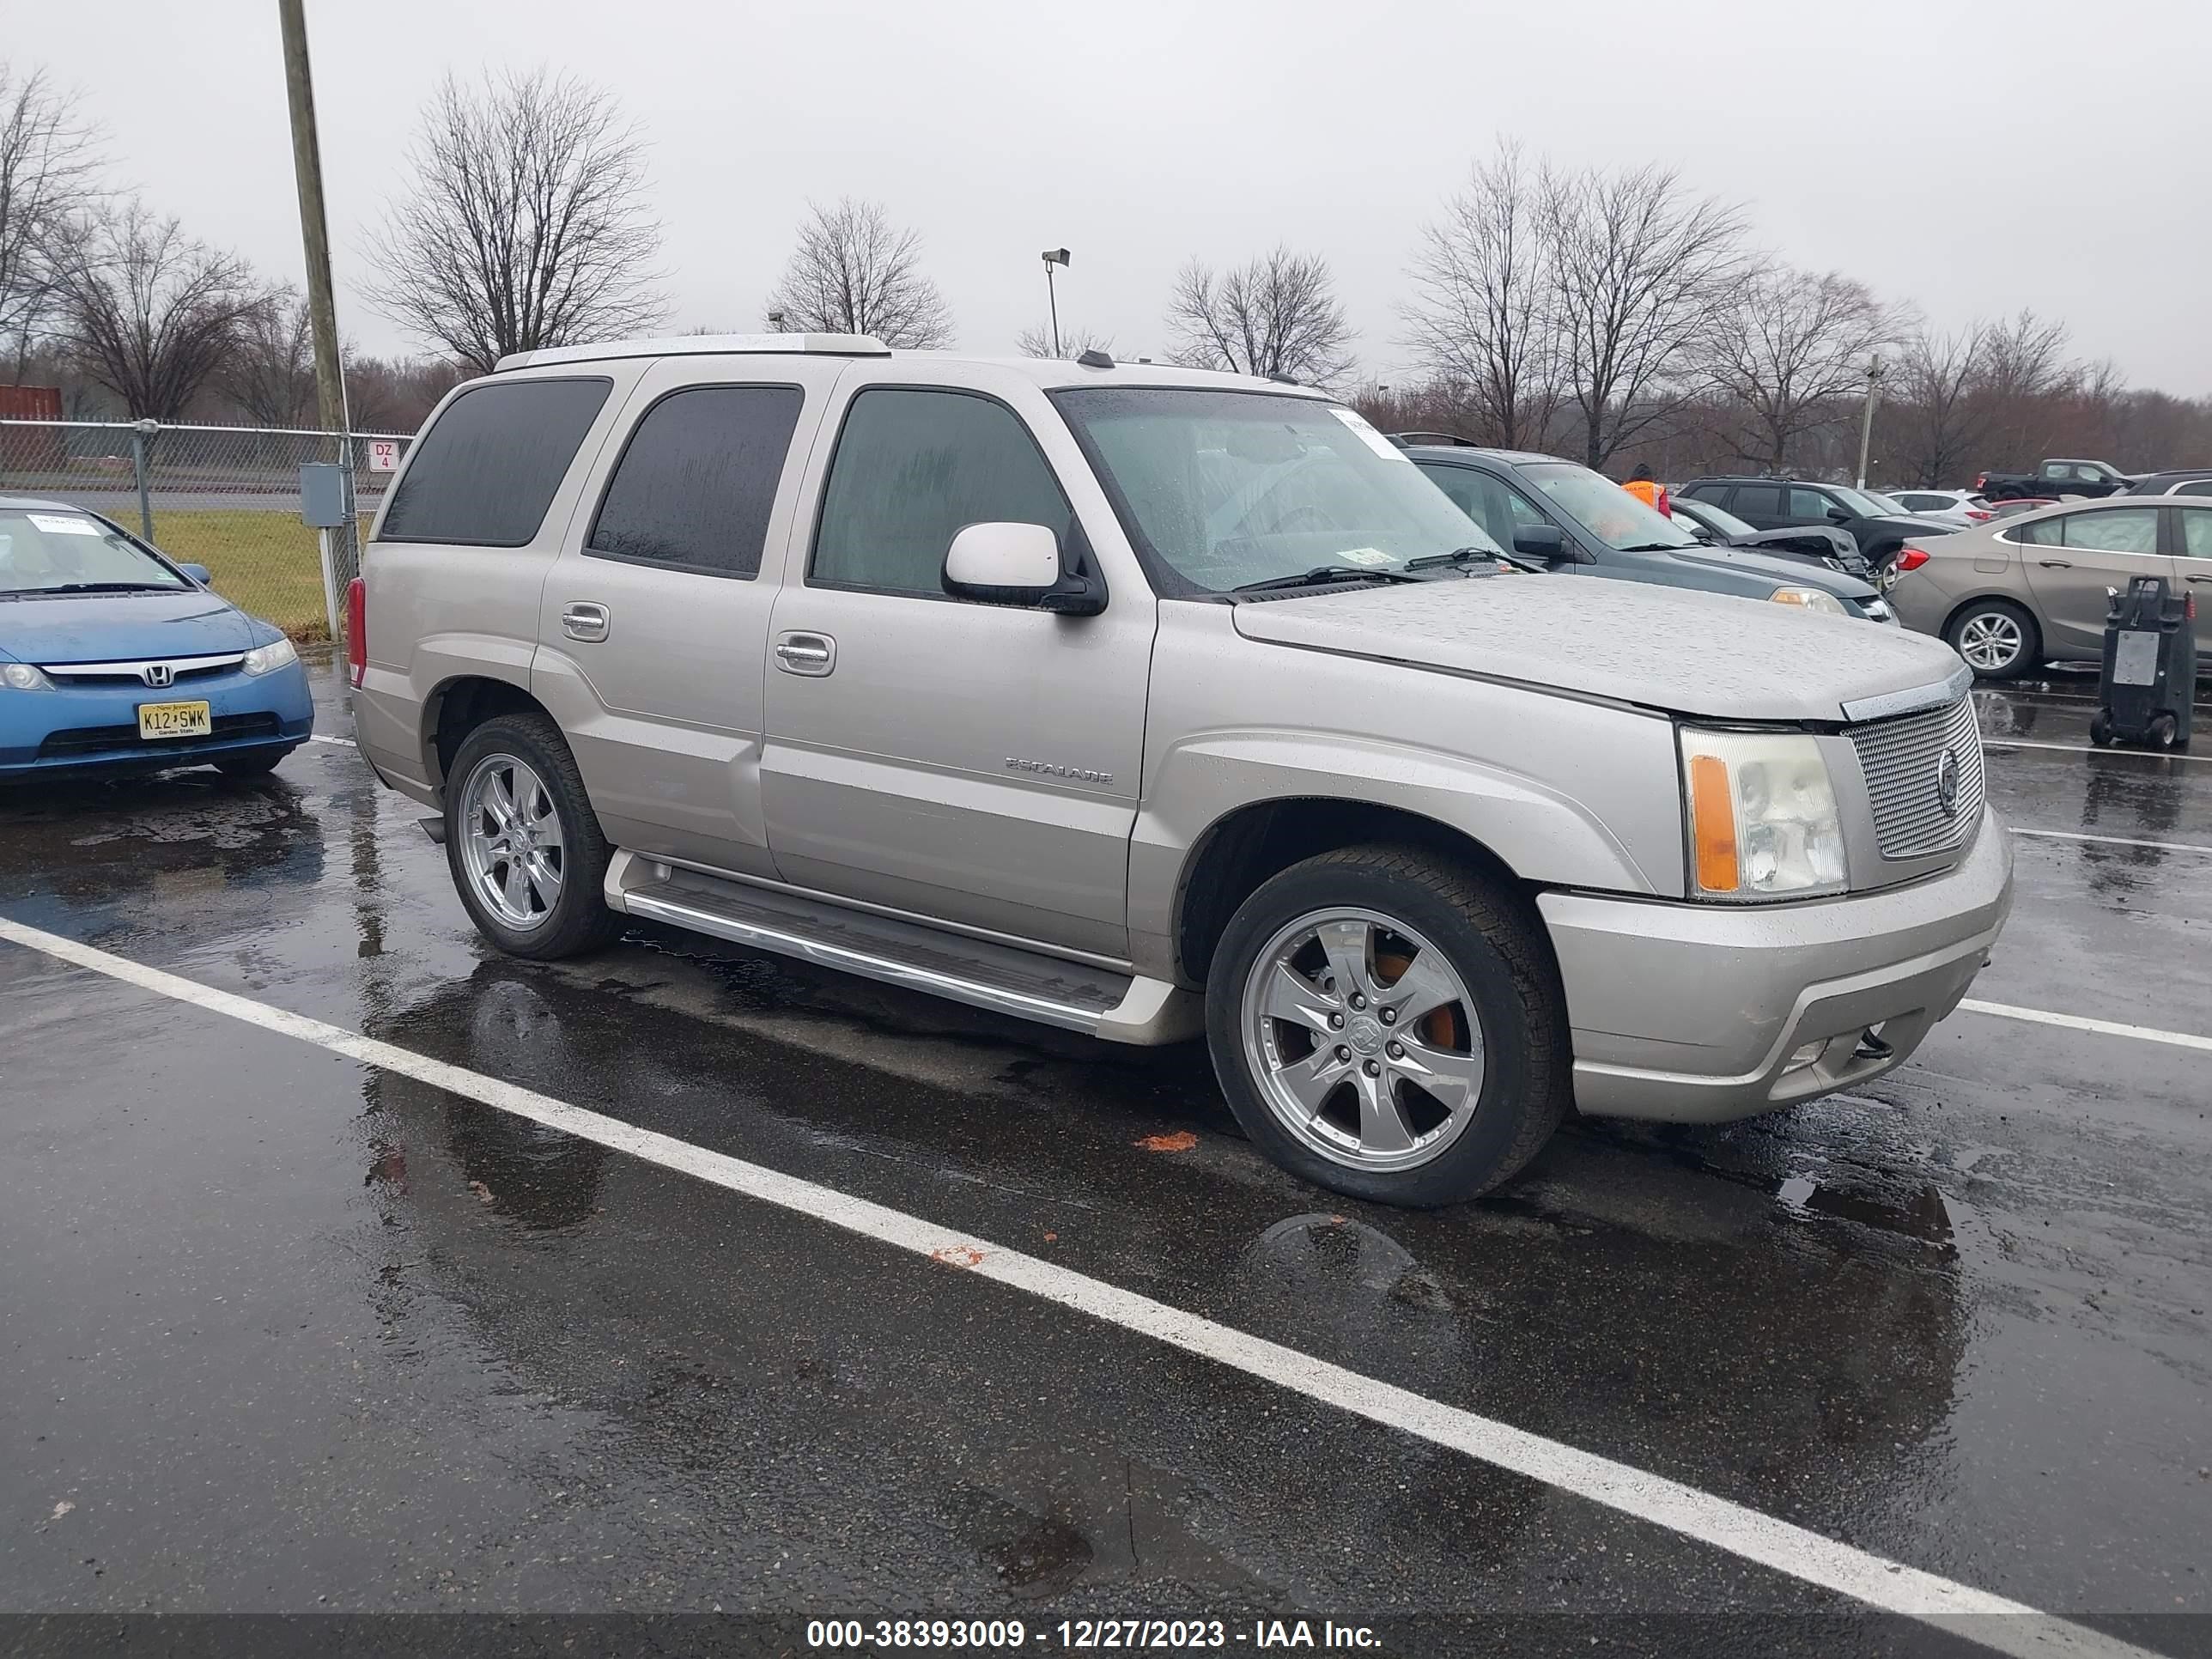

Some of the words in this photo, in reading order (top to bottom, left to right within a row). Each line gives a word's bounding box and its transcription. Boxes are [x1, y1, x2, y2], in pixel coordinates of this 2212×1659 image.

[376, 444, 392, 456] DZ
[382, 457, 389, 468] 4
[1006, 757, 1114, 786] ESCALADE
